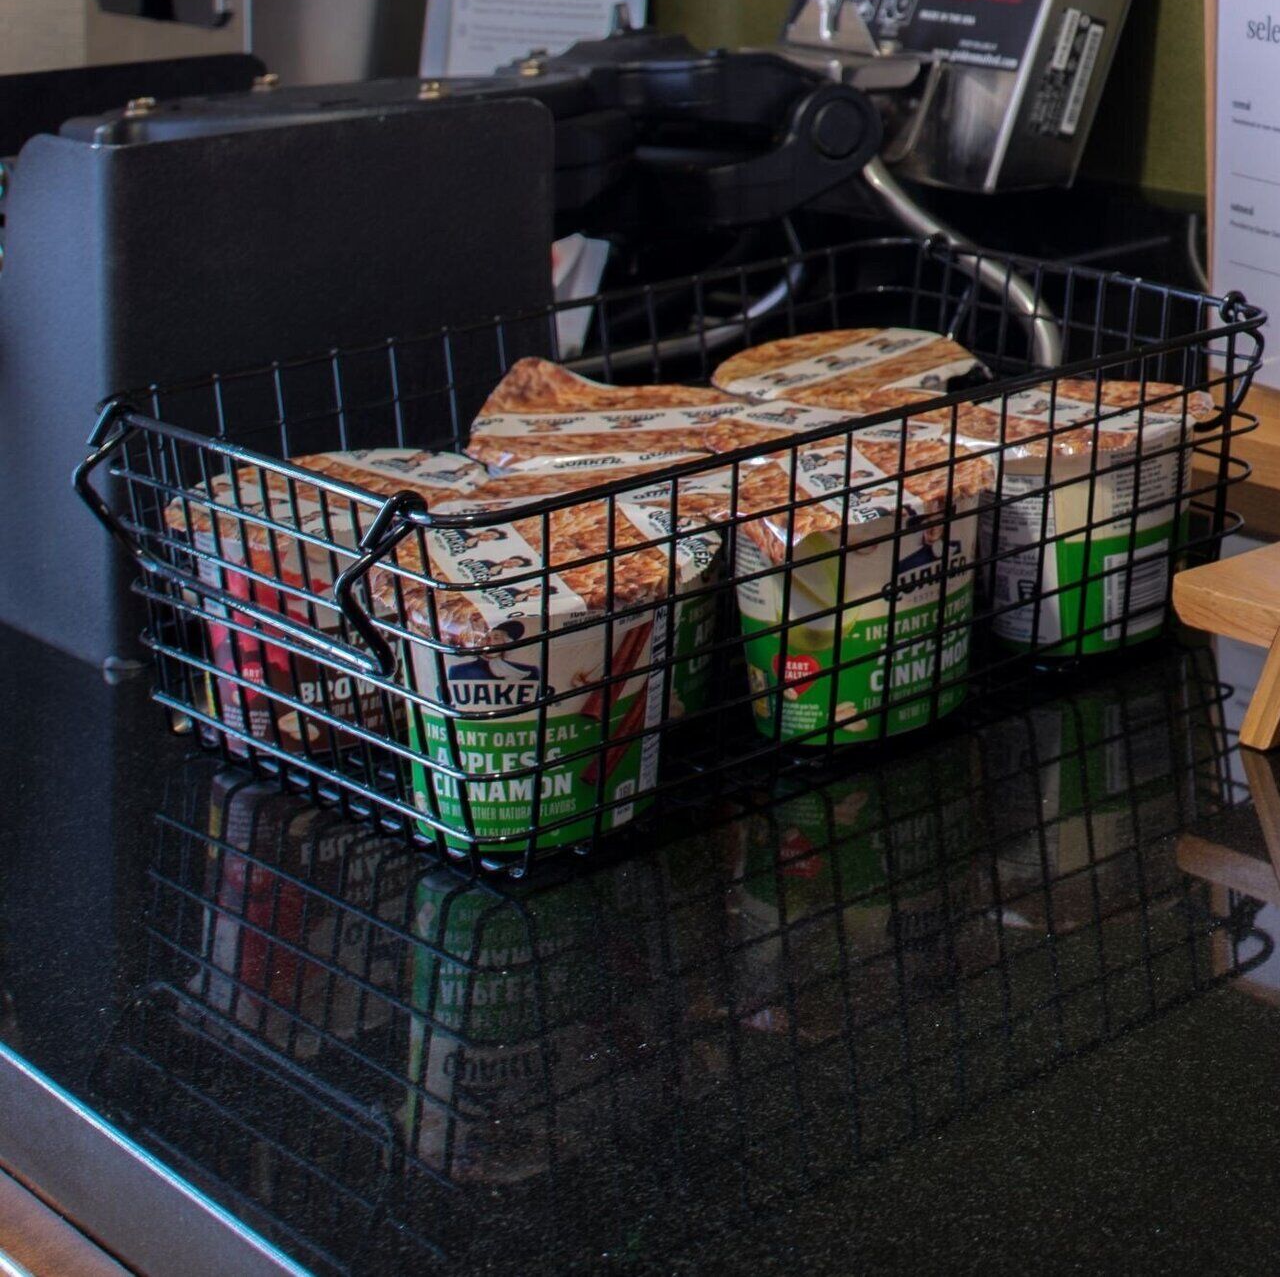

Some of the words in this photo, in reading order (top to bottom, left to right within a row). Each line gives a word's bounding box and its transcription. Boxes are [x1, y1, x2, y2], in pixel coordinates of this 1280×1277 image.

[784, 661, 810, 671] EART
[426, 722, 488, 747] INSANT
[499, 804, 532, 820] NATURA
